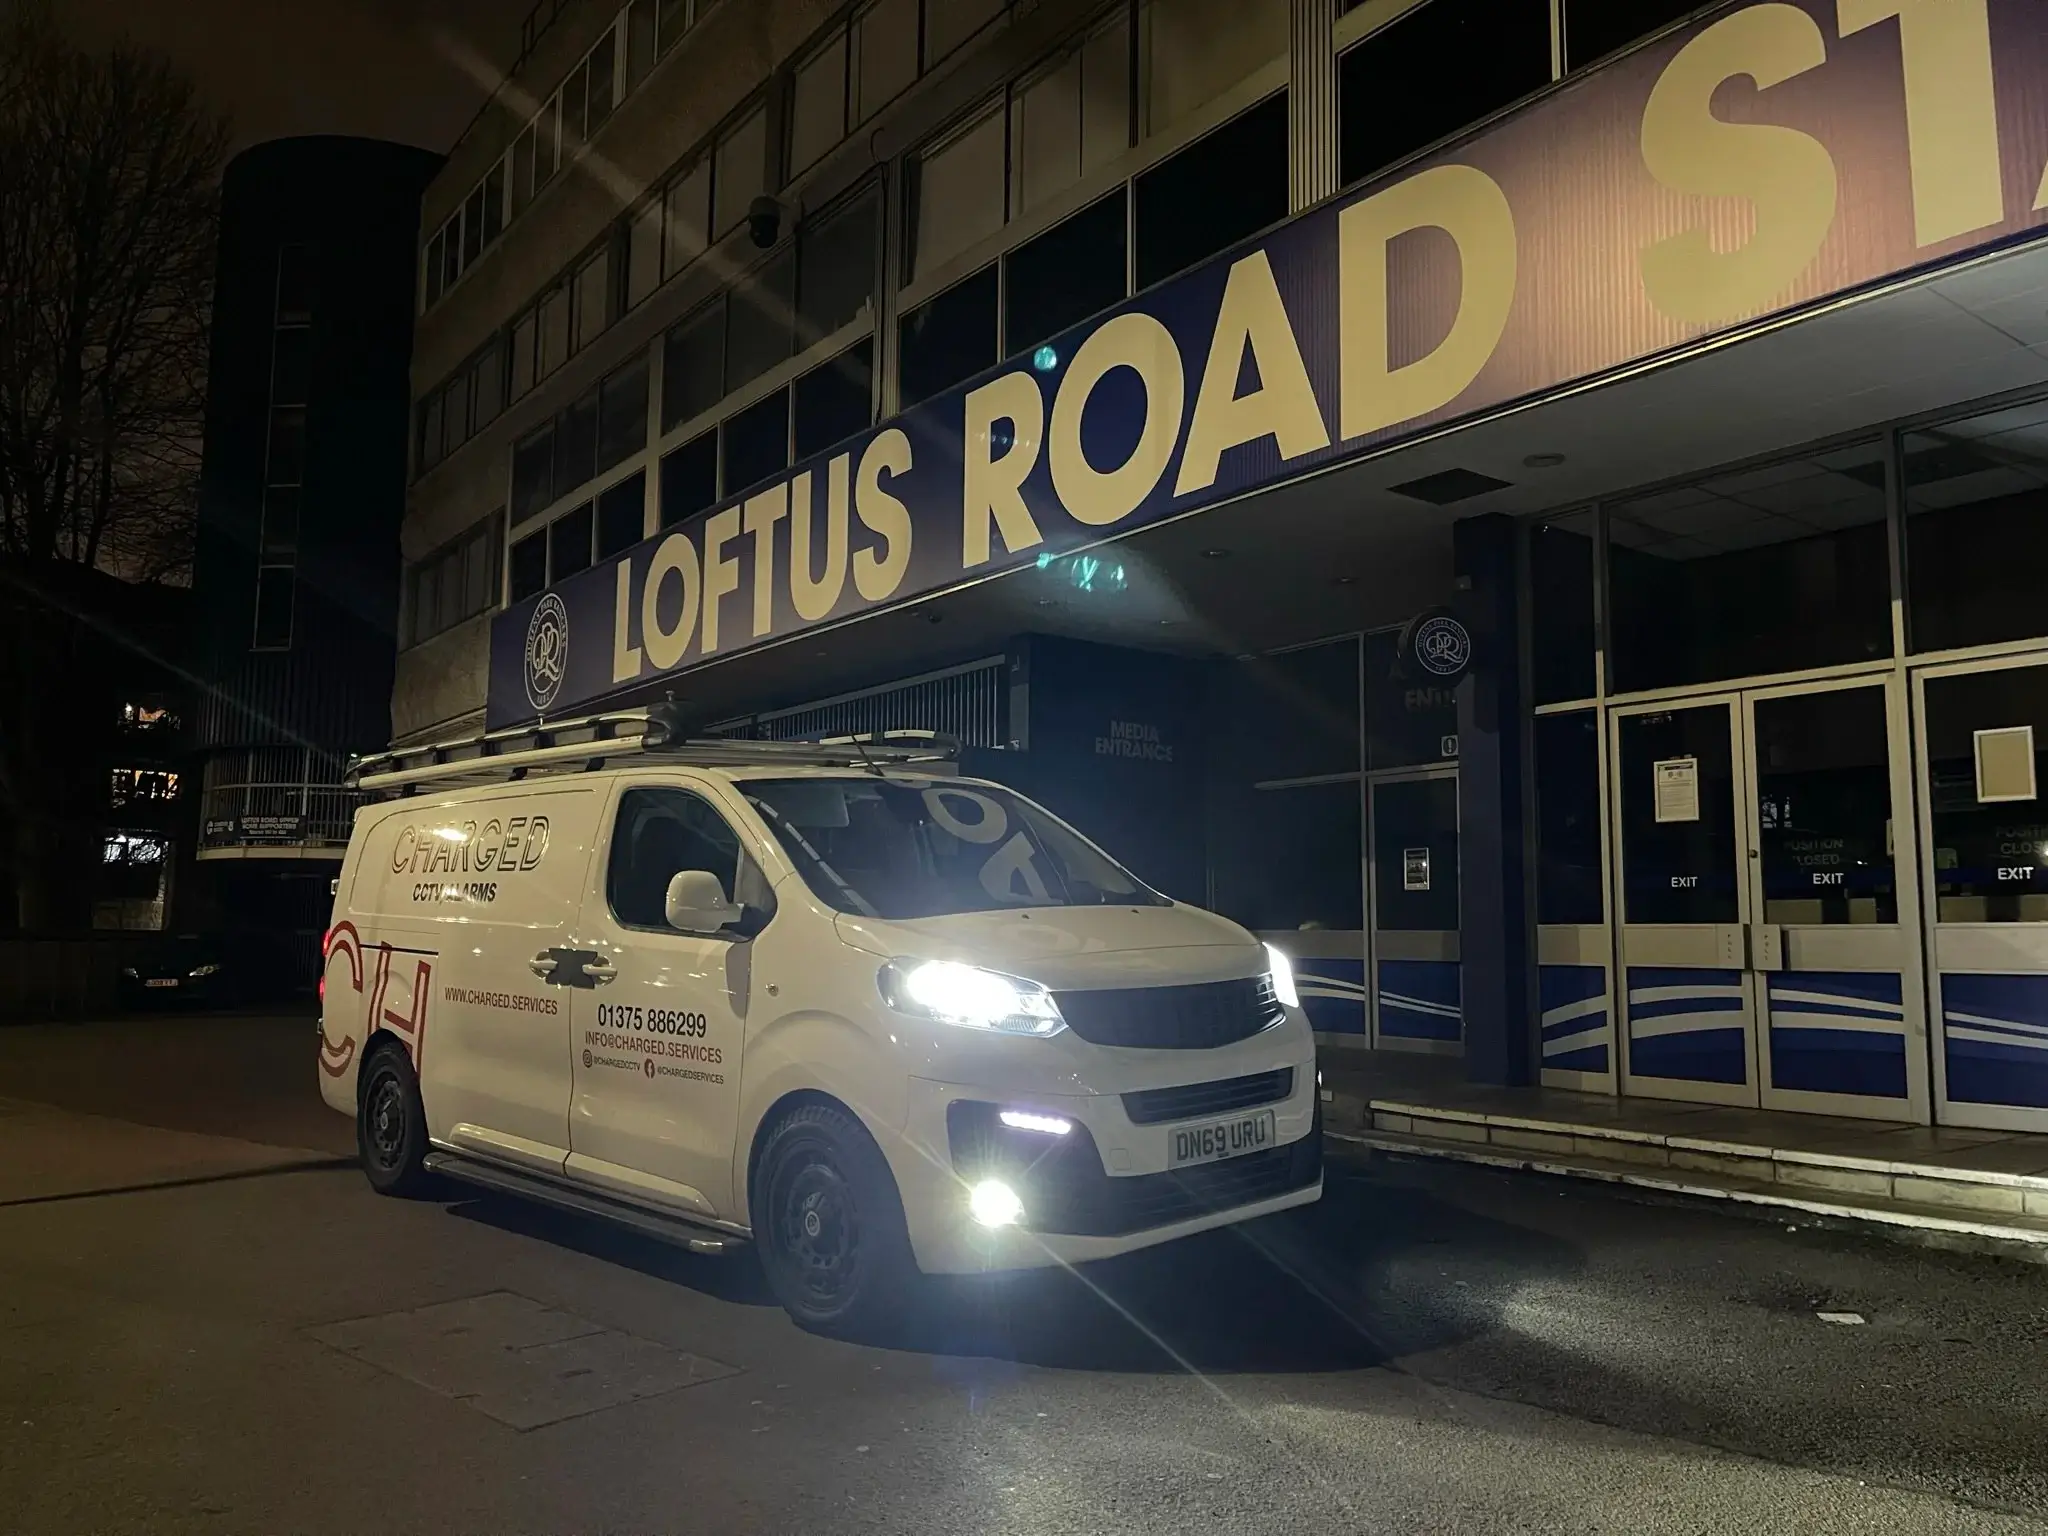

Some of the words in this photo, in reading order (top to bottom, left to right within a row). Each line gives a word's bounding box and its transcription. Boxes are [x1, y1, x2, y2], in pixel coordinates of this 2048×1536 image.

[613, 428, 912, 684] LOFTUS
[963, 164, 1517, 569] ROAD
[1639, 0, 2048, 325] ST
[1111, 720, 1159, 743] MEDIA
[1095, 737, 1173, 762] ENTRANCE
[392, 815, 550, 874] CHARGED
[1671, 876, 1699, 888] EXIT
[1812, 872, 1845, 885] EXIT
[1996, 866, 2035, 881] EXIT
[444, 987, 558, 1016] WWW.CHARGED.SERVICES
[598, 1003, 643, 1031] 01375
[647, 1008, 707, 1038] 886299
[585, 1030, 722, 1064] INFO@CHARGED.SERVICES
[657, 1066, 725, 1085] @CHARGEDSERVICES
[1176, 1125, 1226, 1161] DN69
[1230, 1115, 1265, 1149] URU
